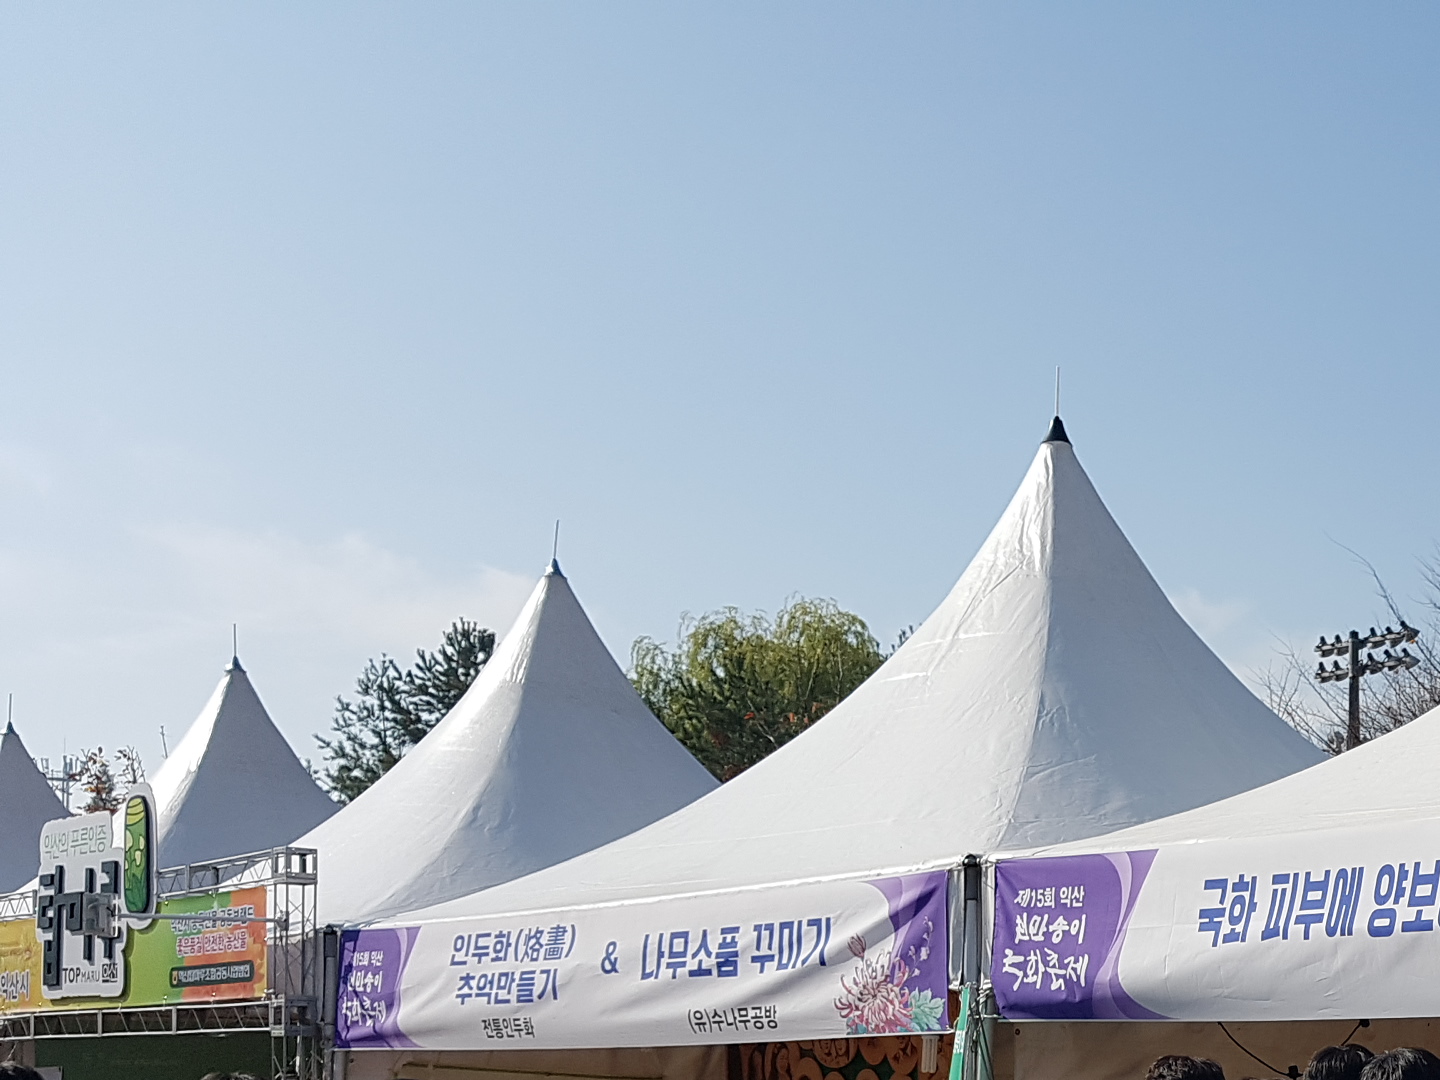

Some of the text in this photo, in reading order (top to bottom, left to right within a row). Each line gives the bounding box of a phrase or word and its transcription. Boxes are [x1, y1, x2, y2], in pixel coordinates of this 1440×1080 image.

[44, 824, 107, 860] 익산의 푸른인증
[1014, 885, 1085, 909] 제15회 익산
[1198, 872, 1260, 948] 국화
[1260, 865, 1365, 942] 피부에
[1015, 912, 1087, 944] 천만송이
[600, 941, 620, 976] &
[640, 925, 741, 981] 나무소품
[750, 916, 832, 974] 꾸미기
[0, 970, 30, 1000] 익산시
[102, 963, 118, 983] 익산
[455, 968, 559, 1005] 추억만들기
[481, 1017, 536, 1039] 전통인두화
[687, 1004, 779, 1034] (유)수나무공방
